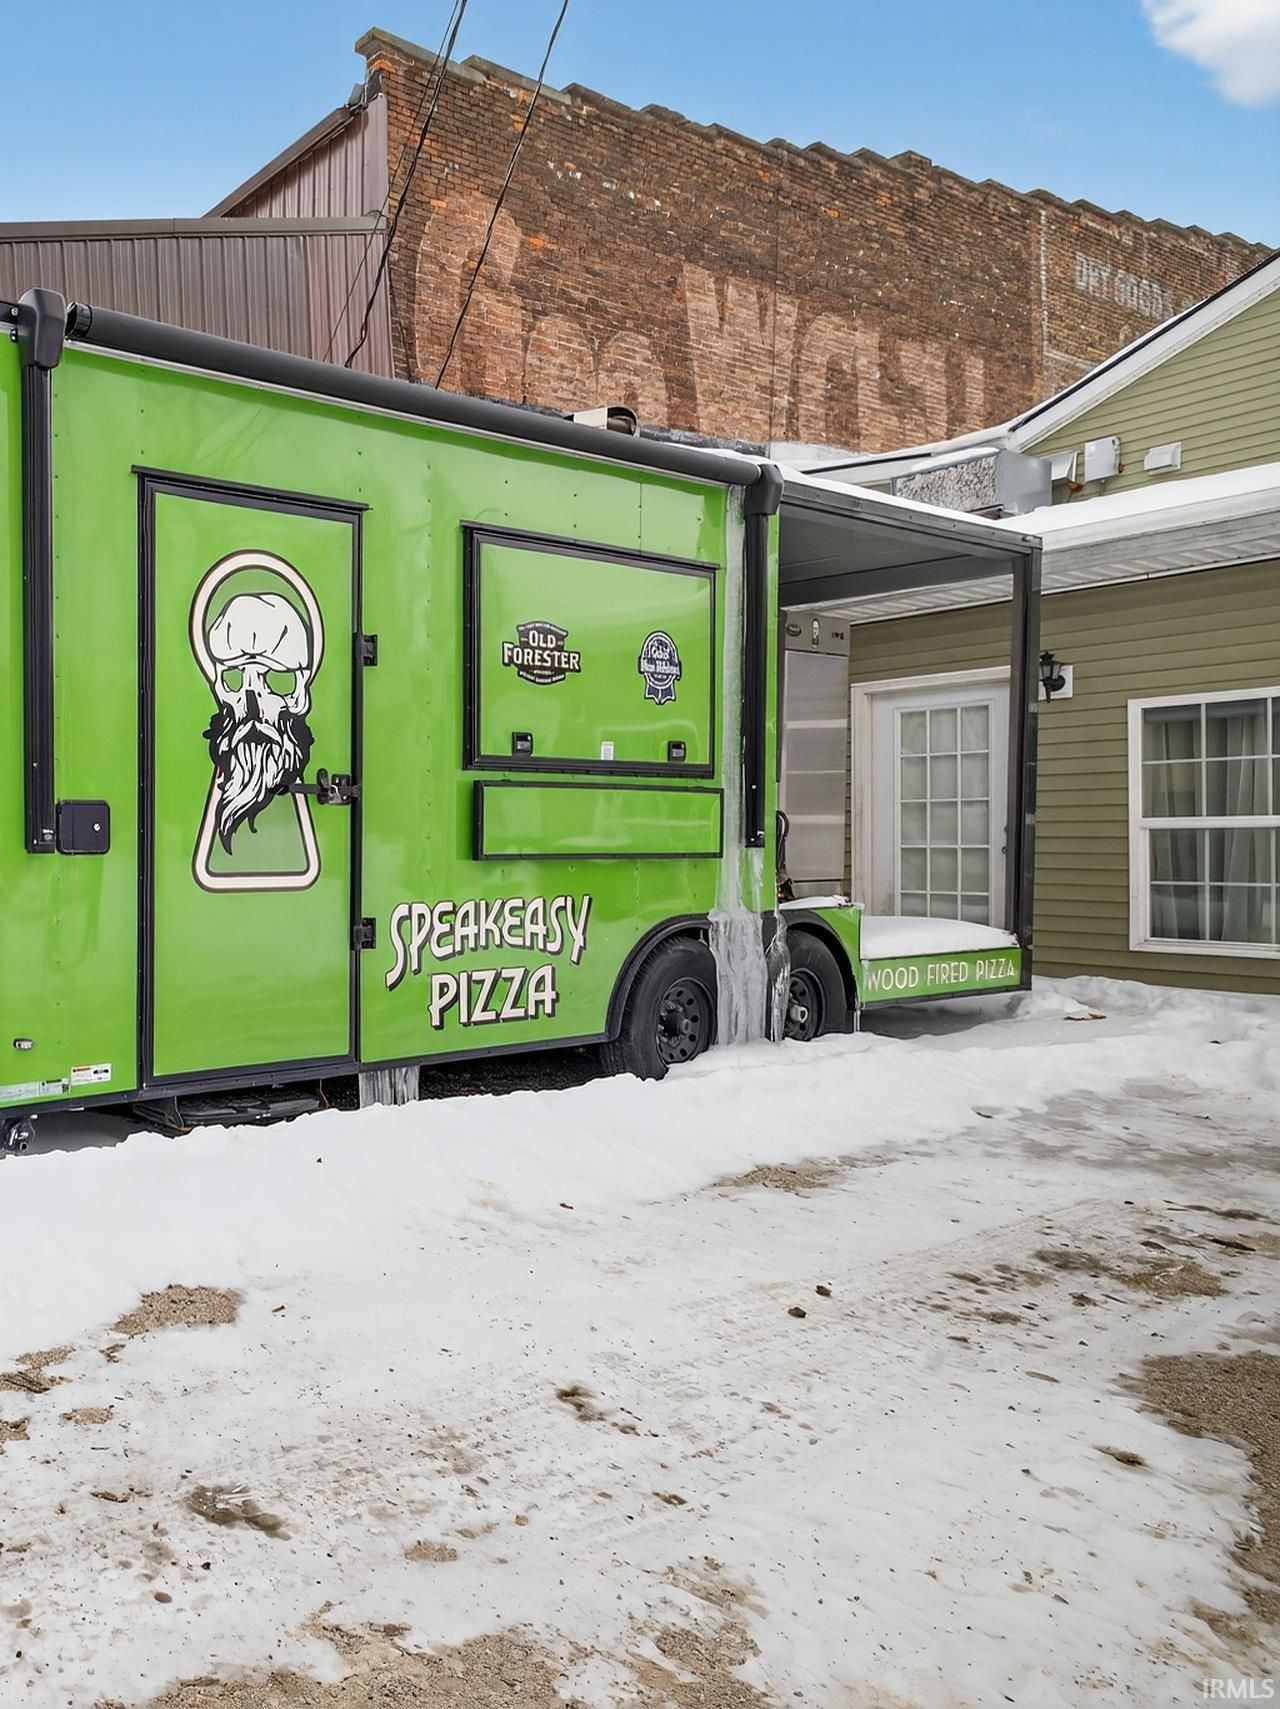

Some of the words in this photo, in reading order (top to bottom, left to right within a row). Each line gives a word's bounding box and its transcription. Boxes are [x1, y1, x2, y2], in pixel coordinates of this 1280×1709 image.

[503, 642, 580, 670] FORESTER
[529, 630, 556, 648] OLD
[385, 894, 592, 991] SPEAKEASY
[865, 966, 919, 992] WOOD
[927, 961, 968, 986] FIRED
[976, 958, 1015, 981] PIZZA
[428, 964, 559, 1029] PIZZA
